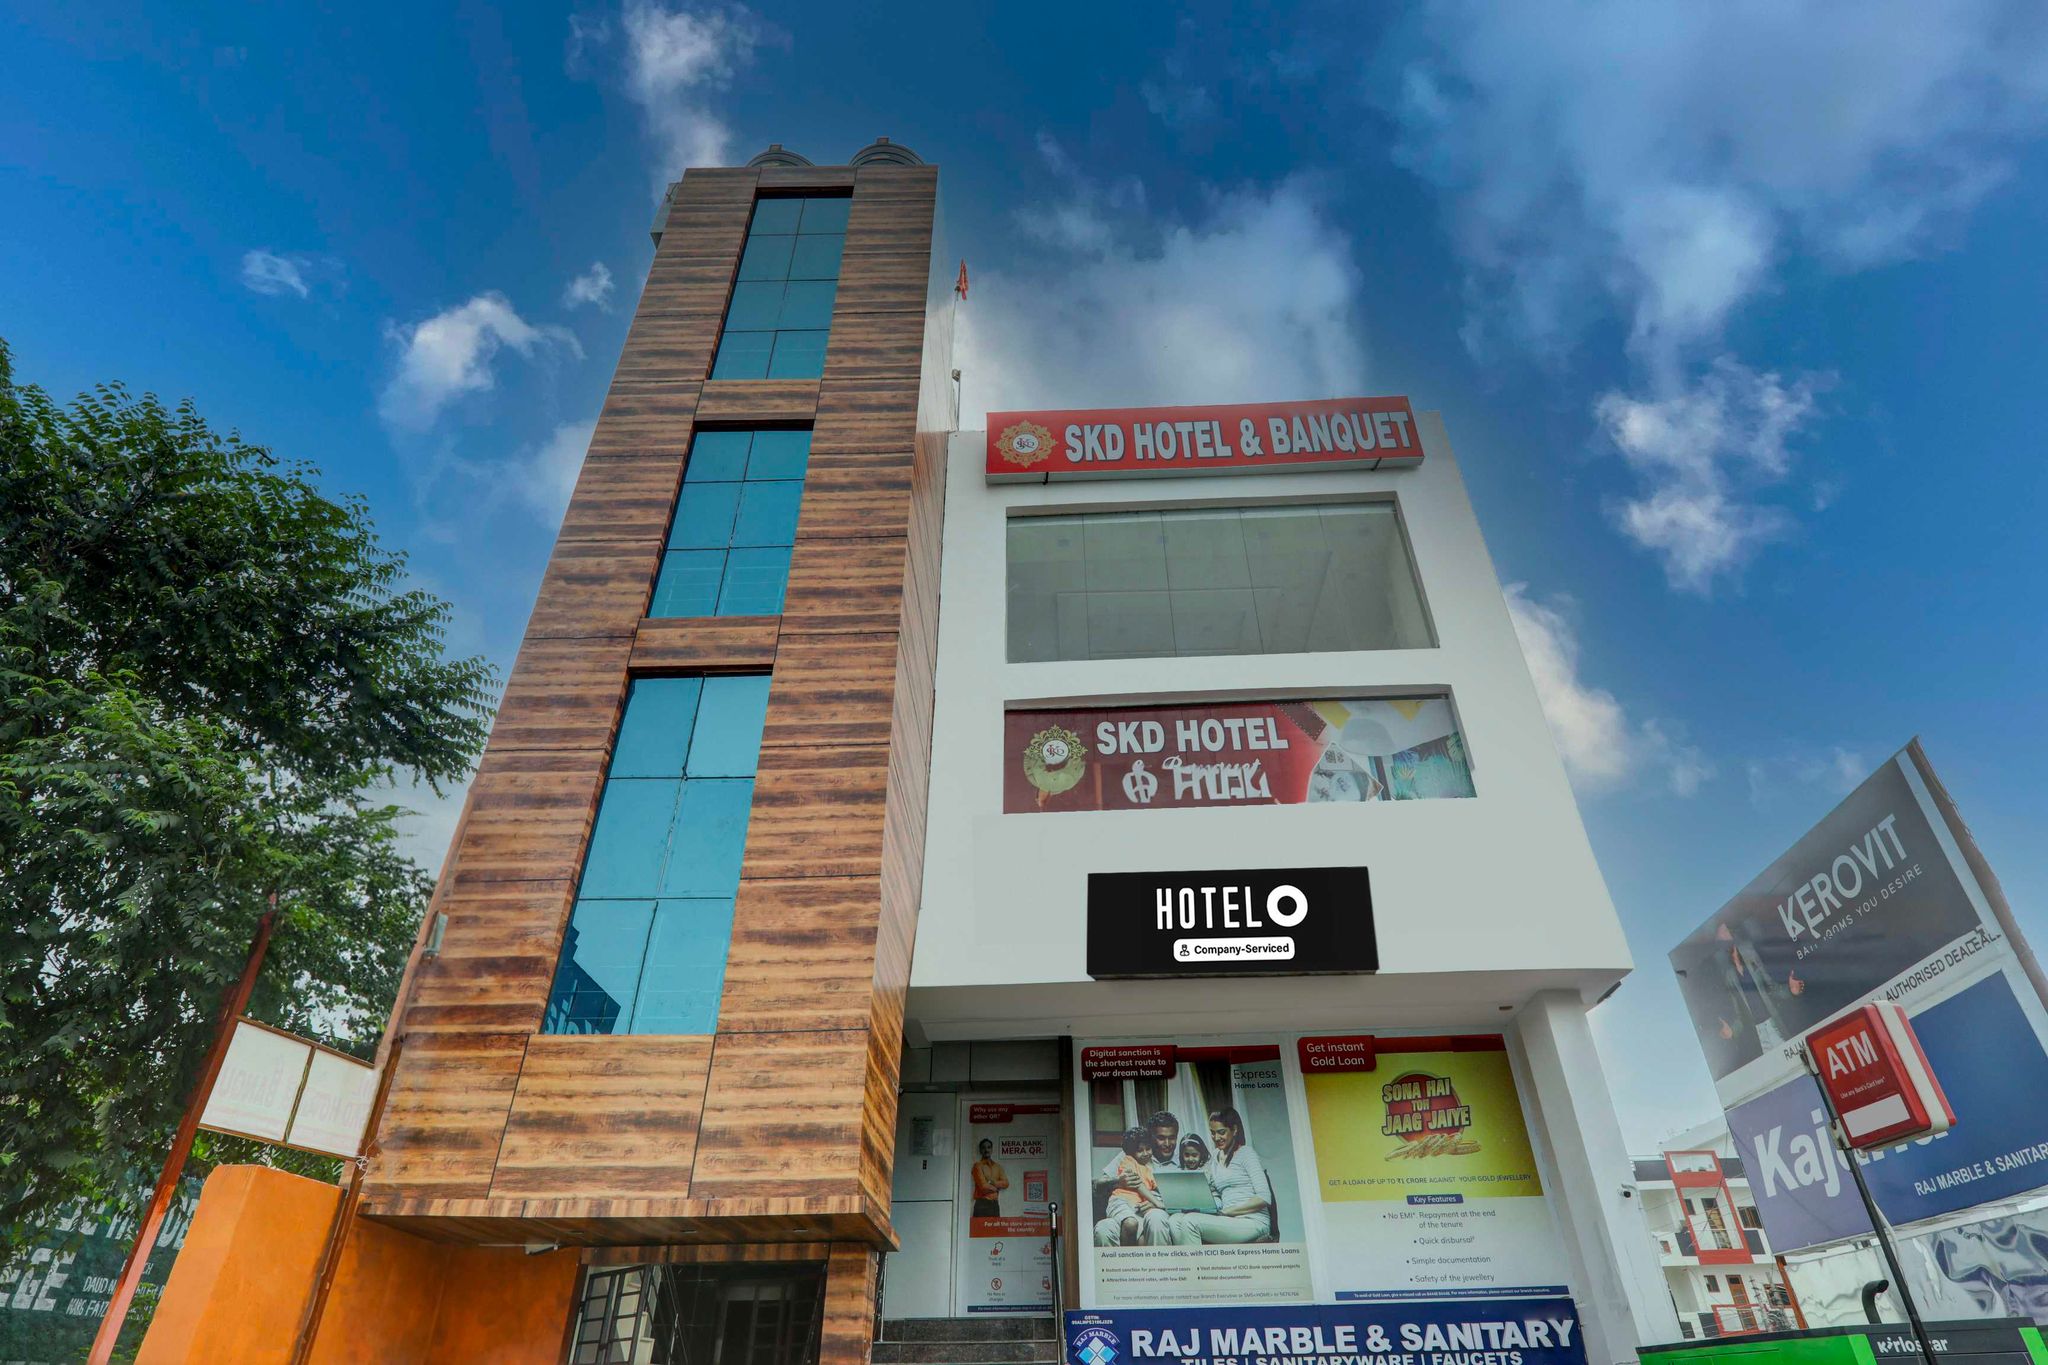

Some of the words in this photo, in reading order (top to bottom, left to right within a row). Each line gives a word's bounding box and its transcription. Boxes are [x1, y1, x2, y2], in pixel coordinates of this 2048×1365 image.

[1064, 423, 1125, 462] SKD
[1134, 420, 1232, 460] HOTEL
[1240, 418, 1265, 456] &
[1269, 411, 1411, 454] BANQUET
[1097, 720, 1165, 754] SKD
[1176, 717, 1289, 752] HOTEL
[1777, 814, 1907, 940] KEROVIT
[1856, 896, 1878, 917] YOU
[1880, 863, 1923, 900] DESIRE
[1156, 886, 1263, 930] HOTEL
[1194, 943, 1290, 957] Company-Serviced
[1885, 959, 1946, 1002] AUTHORISED
[1089, 1050, 1117, 1058] Digital
[1307, 1043, 1325, 1053] Get
[1327, 1042, 1365, 1052] instant
[1310, 1056, 1336, 1066] Gold
[1338, 1056, 1365, 1065] Loan
[1825, 1030, 1879, 1080] ATM
[1092, 1071, 1110, 1079] your
[1112, 1069, 1138, 1077] dream
[1233, 1068, 1277, 1080] Express
[1234, 1081, 1256, 1089] Home
[1257, 1080, 1280, 1089] Loans
[1382, 1080, 1422, 1102] SONA
[1426, 1078, 1450, 1096] HAI
[1412, 1099, 1430, 1110] TOH
[1383, 1114, 1422, 1135] JAAG
[1428, 1106, 1470, 1129] JAIYE
[1914, 1178, 1937, 1196] RAJ
[1936, 1163, 1985, 1190] MARBLE
[1984, 1160, 1996, 1175] &
[1995, 1141, 2048, 1172] SANITAR
[1496, 1174, 1531, 1182] JEWELLERY
[1413, 1196, 1426, 1204] Key
[1427, 1195, 1456, 1203] Features
[1419, 1211, 1459, 1219] Repayment
[1419, 1237, 1439, 1245] Quick
[1411, 1257, 1436, 1265] Simple
[1437, 1256, 1491, 1264] documentation
[1415, 1275, 1438, 1283] Safety
[1462, 1273, 1495, 1283] jewellery
[1076, 1334, 1088, 1347] RAJ
[1088, 1330, 1117, 1345] MARBLE
[1131, 1328, 1200, 1357] RAJ
[1210, 1325, 1358, 1356] MARBLE
[1366, 1324, 1392, 1353] &
[1400, 1319, 1574, 1351] SANITARY
[1877, 1335, 1948, 1354] kirlosar
[1432, 1351, 1523, 1365] FAUCETS
